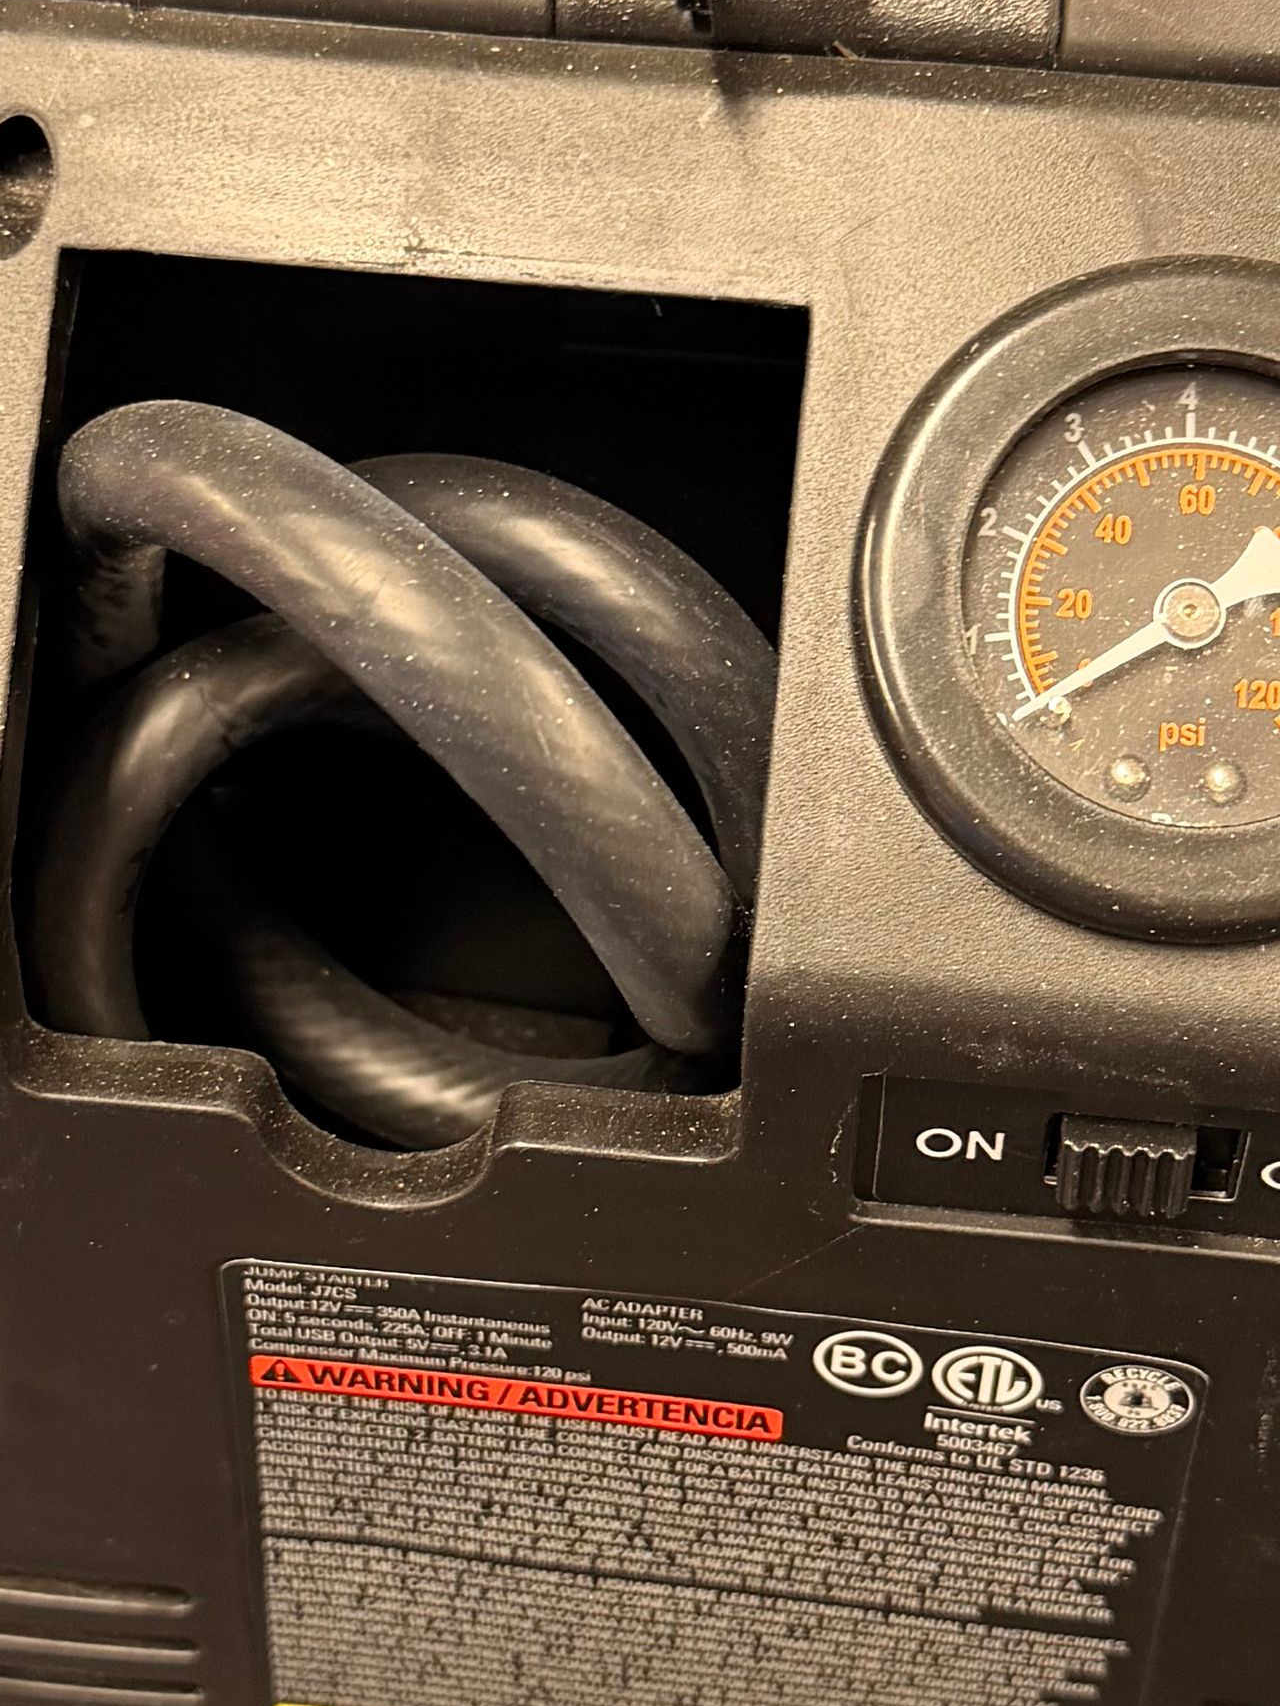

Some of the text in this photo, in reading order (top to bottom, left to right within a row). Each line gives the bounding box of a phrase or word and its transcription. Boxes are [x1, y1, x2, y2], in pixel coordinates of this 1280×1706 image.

[1179, 382, 1199, 411] 4
[1064, 413, 1083, 442] 3
[1179, 484, 1216, 516] 60
[978, 507, 999, 537] 2
[1094, 513, 1132, 545] 40
[1055, 588, 1093, 619] 20
[1158, 717, 1207, 752] psi
[916, 1128, 1007, 1161] ON
[244, 1278, 357, 1300] Model: J7CS
[376, 1306, 420, 1321] 350A
[424, 1312, 550, 1334] Instantaneous
[581, 1296, 703, 1321] AC ADAPTER
[247, 1308, 281, 1322] ON:
[285, 1311, 295, 1323] 5
[476, 1330, 484, 1342] 1
[489, 1332, 552, 1349] Minute
[249, 1322, 294, 1338] Total
[297, 1327, 336, 1341] USB
[339, 1331, 403, 1349] Output:
[467, 1344, 507, 1358] 3.1A
[581, 1326, 645, 1346] Output:
[726, 1342, 788, 1360] 500mA
[583, 1312, 632, 1330] Input:
[760, 1331, 793, 1346] 9W
[250, 1338, 354, 1359] Compressor
[359, 1349, 445, 1367] Maximum
[564, 1368, 591, 1384] psi
[830, 1344, 908, 1382] BC
[946, 1355, 1028, 1405] ETL
[1100, 1367, 1182, 1392] RECYCLE
[307, 1363, 770, 1432] WARNING / ADVERTENCIA
[923, 1412, 1033, 1445] Intertek
[935, 1433, 1019, 1457] 5003467
[750, 1441, 870, 1467] UNDERSTAND
[872, 1458, 907, 1473] THE
[909, 1463, 1027, 1490] INSTRUCTION
[846, 1434, 1105, 1483] Conforms to UL STD 1236
[795, 1461, 874, 1482] BATTERY
[875, 1472, 932, 1491] LEADS
[934, 1481, 982, 1497] ONLY
[981, 1488, 1039, 1505] WHEN
[1041, 1496, 1111, 1514] SUPPLY
[1110, 1505, 1162, 1520] CORD
[806, 1476, 899, 1499] INSTALLED
[902, 1490, 922, 1503] IN
[924, 1494, 941, 1505] A
[1017, 1506, 1067, 1522] FIRST
[1067, 1513, 1154, 1534] CONNECT
